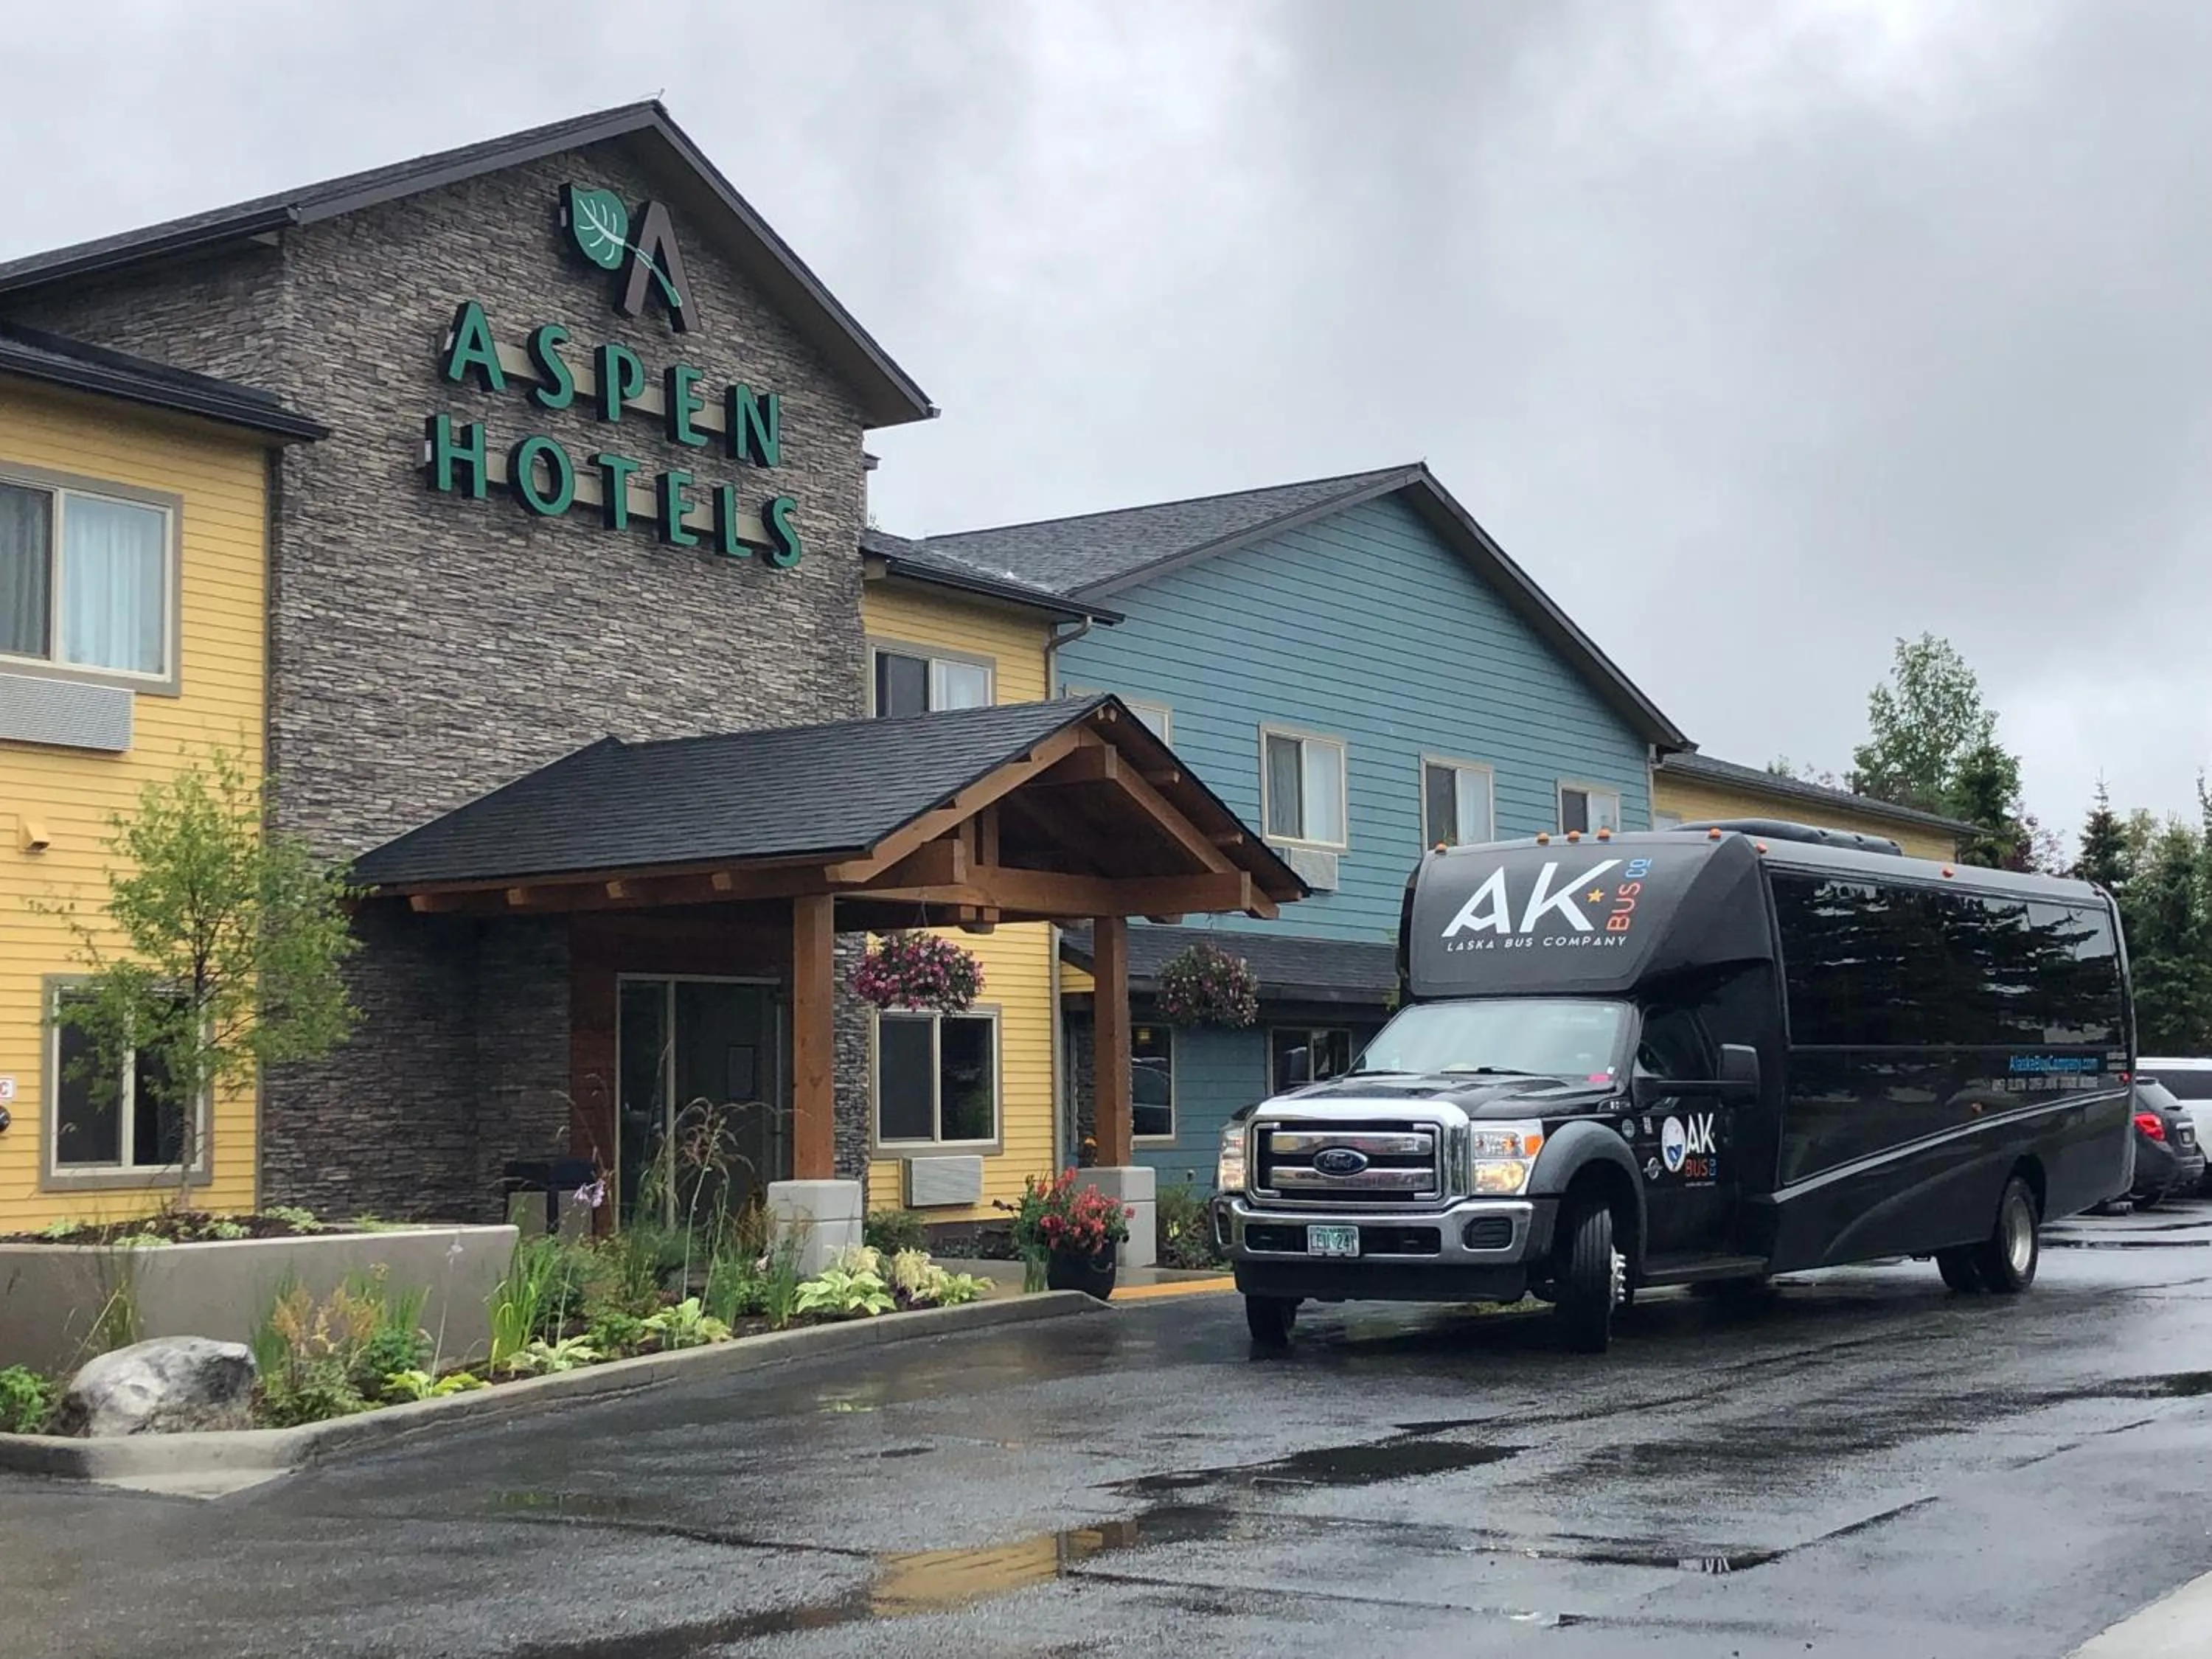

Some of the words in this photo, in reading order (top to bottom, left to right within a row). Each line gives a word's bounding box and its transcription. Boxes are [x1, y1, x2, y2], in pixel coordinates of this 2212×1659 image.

[447, 299, 780, 468] ASPEN
[425, 411, 802, 568] HOTELS
[1441, 859, 1622, 938] AK
[1606, 882, 1641, 931] BUS
[1447, 939, 1495, 952] LASKA
[1504, 937, 1534, 948] BUS
[1543, 936, 1627, 947] COMPANY
[1686, 1113, 1717, 1154] AK
[1685, 1158, 1708, 1178] BUS
